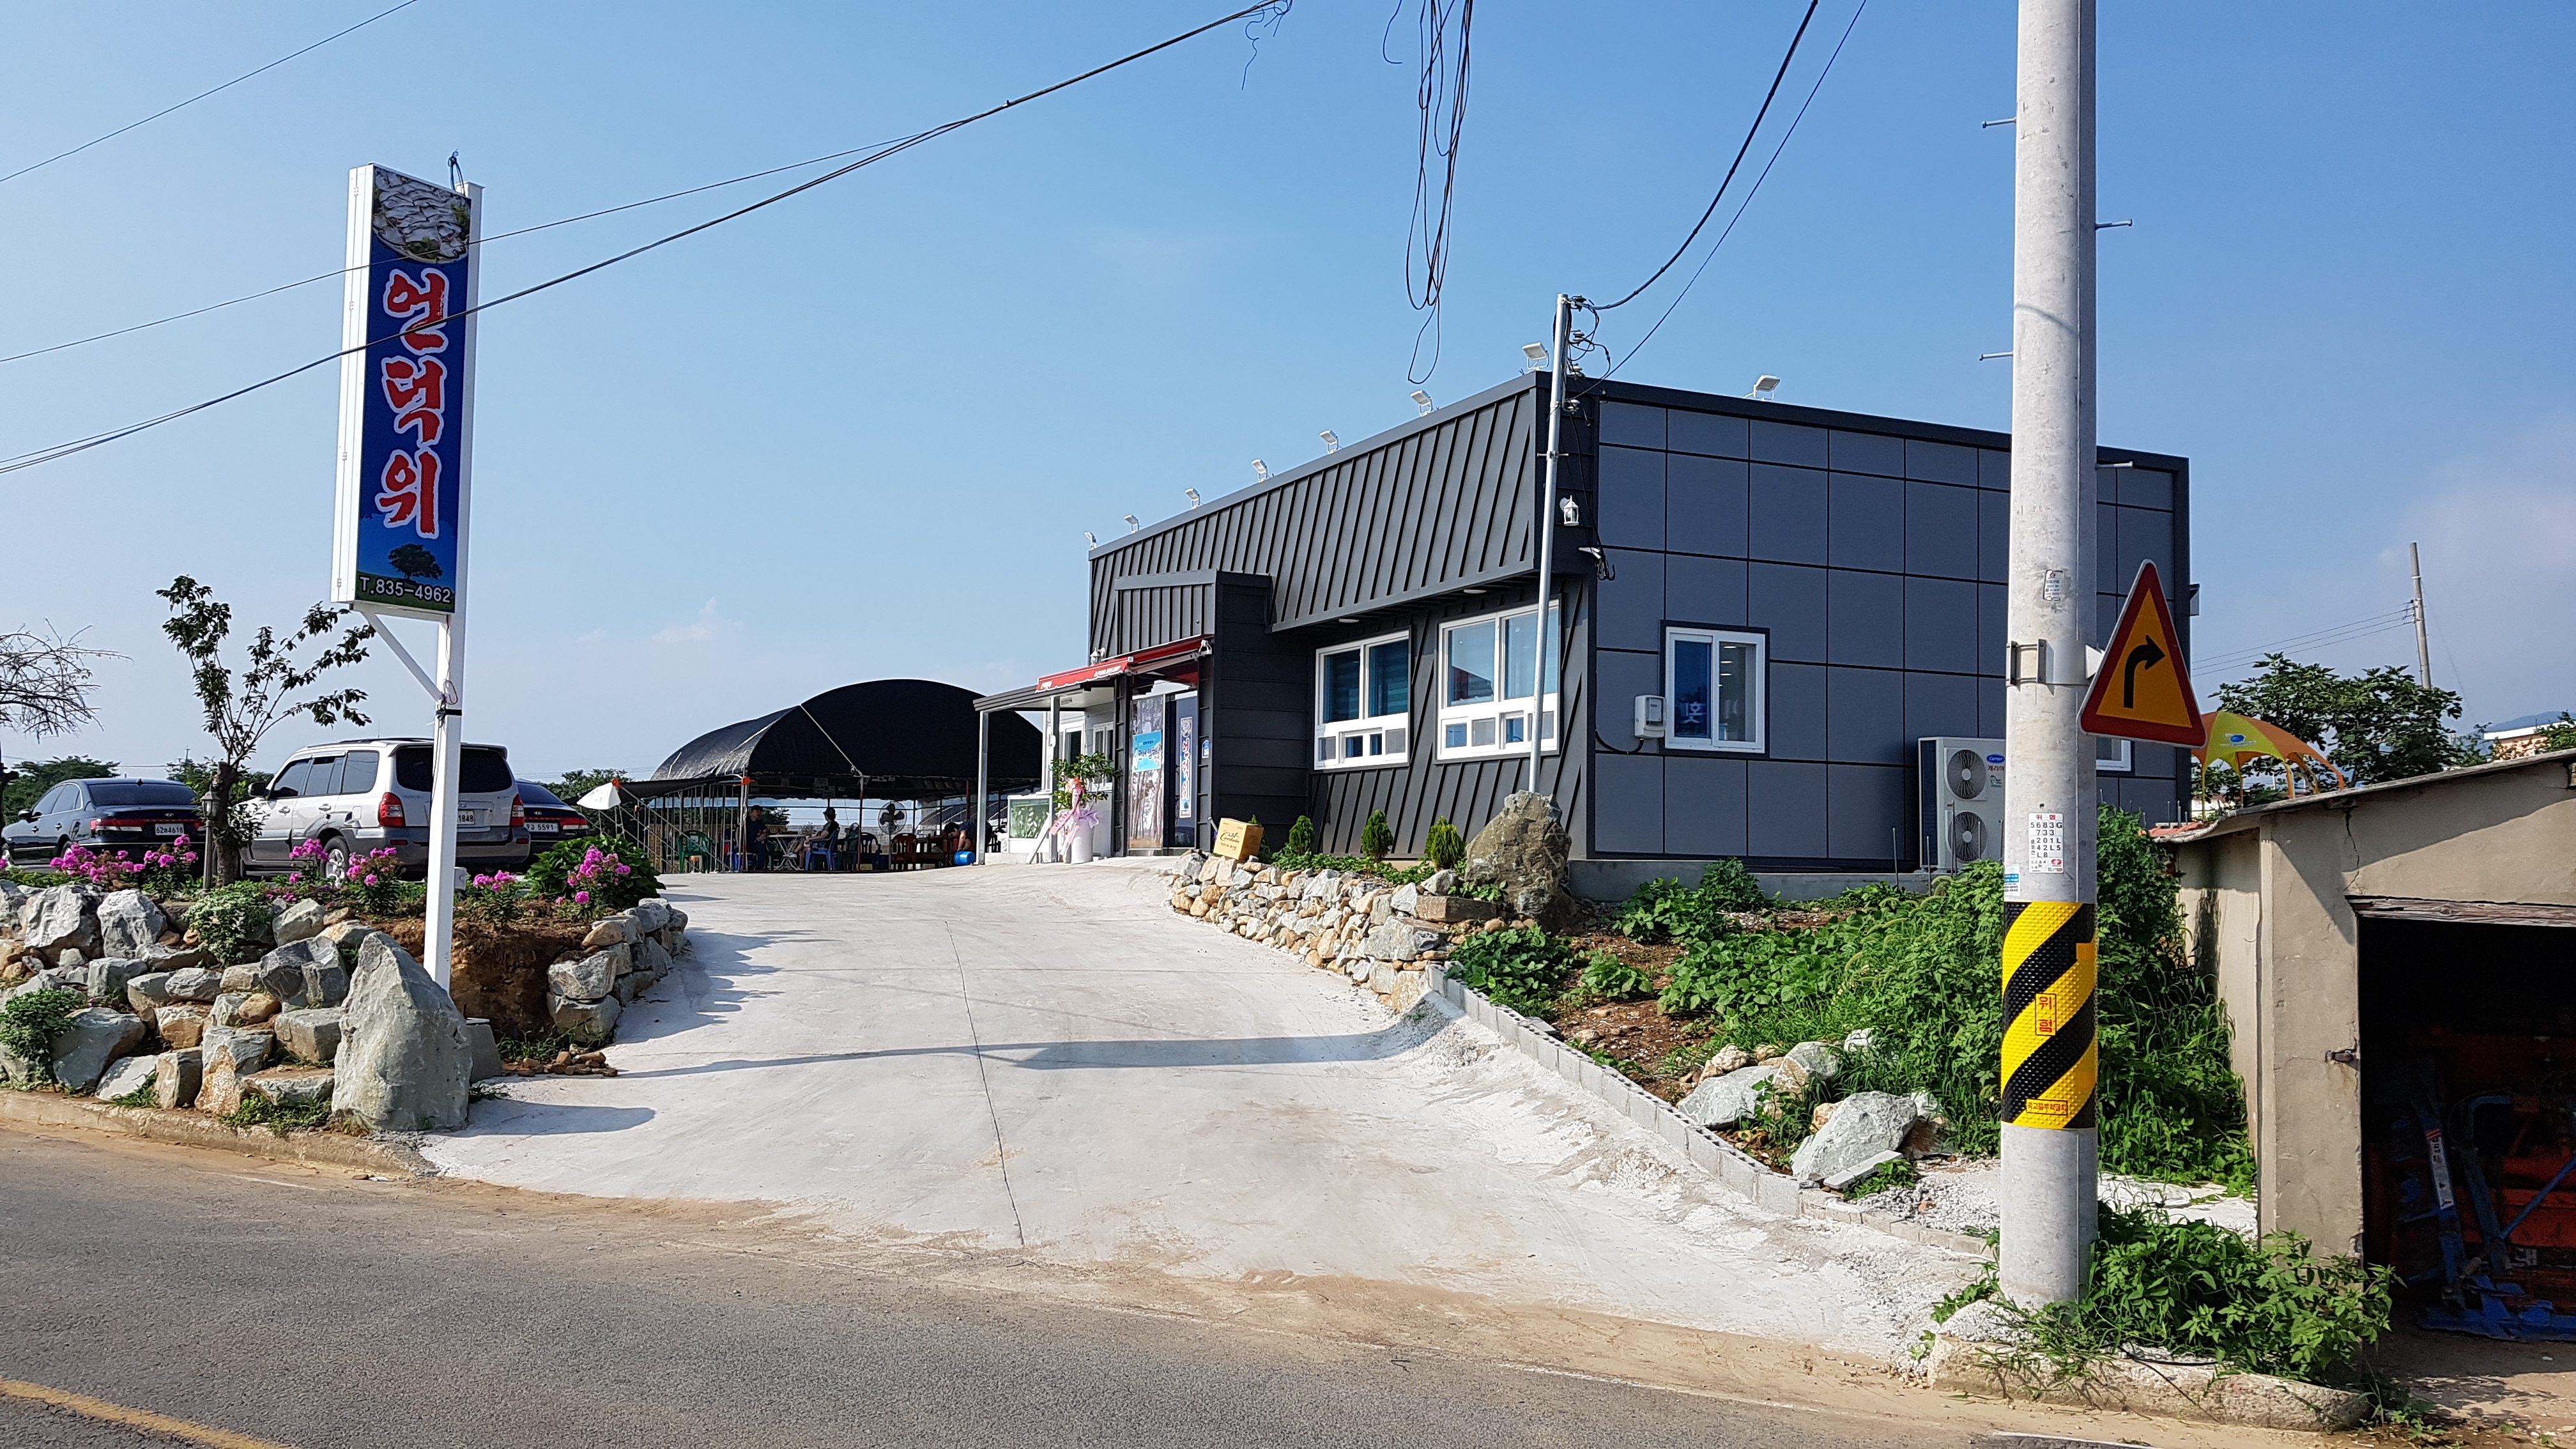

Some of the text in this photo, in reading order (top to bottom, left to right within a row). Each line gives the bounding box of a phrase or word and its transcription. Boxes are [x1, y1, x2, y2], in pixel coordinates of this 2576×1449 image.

[378, 268, 448, 538] 언덕위
[360, 576, 450, 602] T.835-4962
[2039, 996, 2052, 1032] 위험
